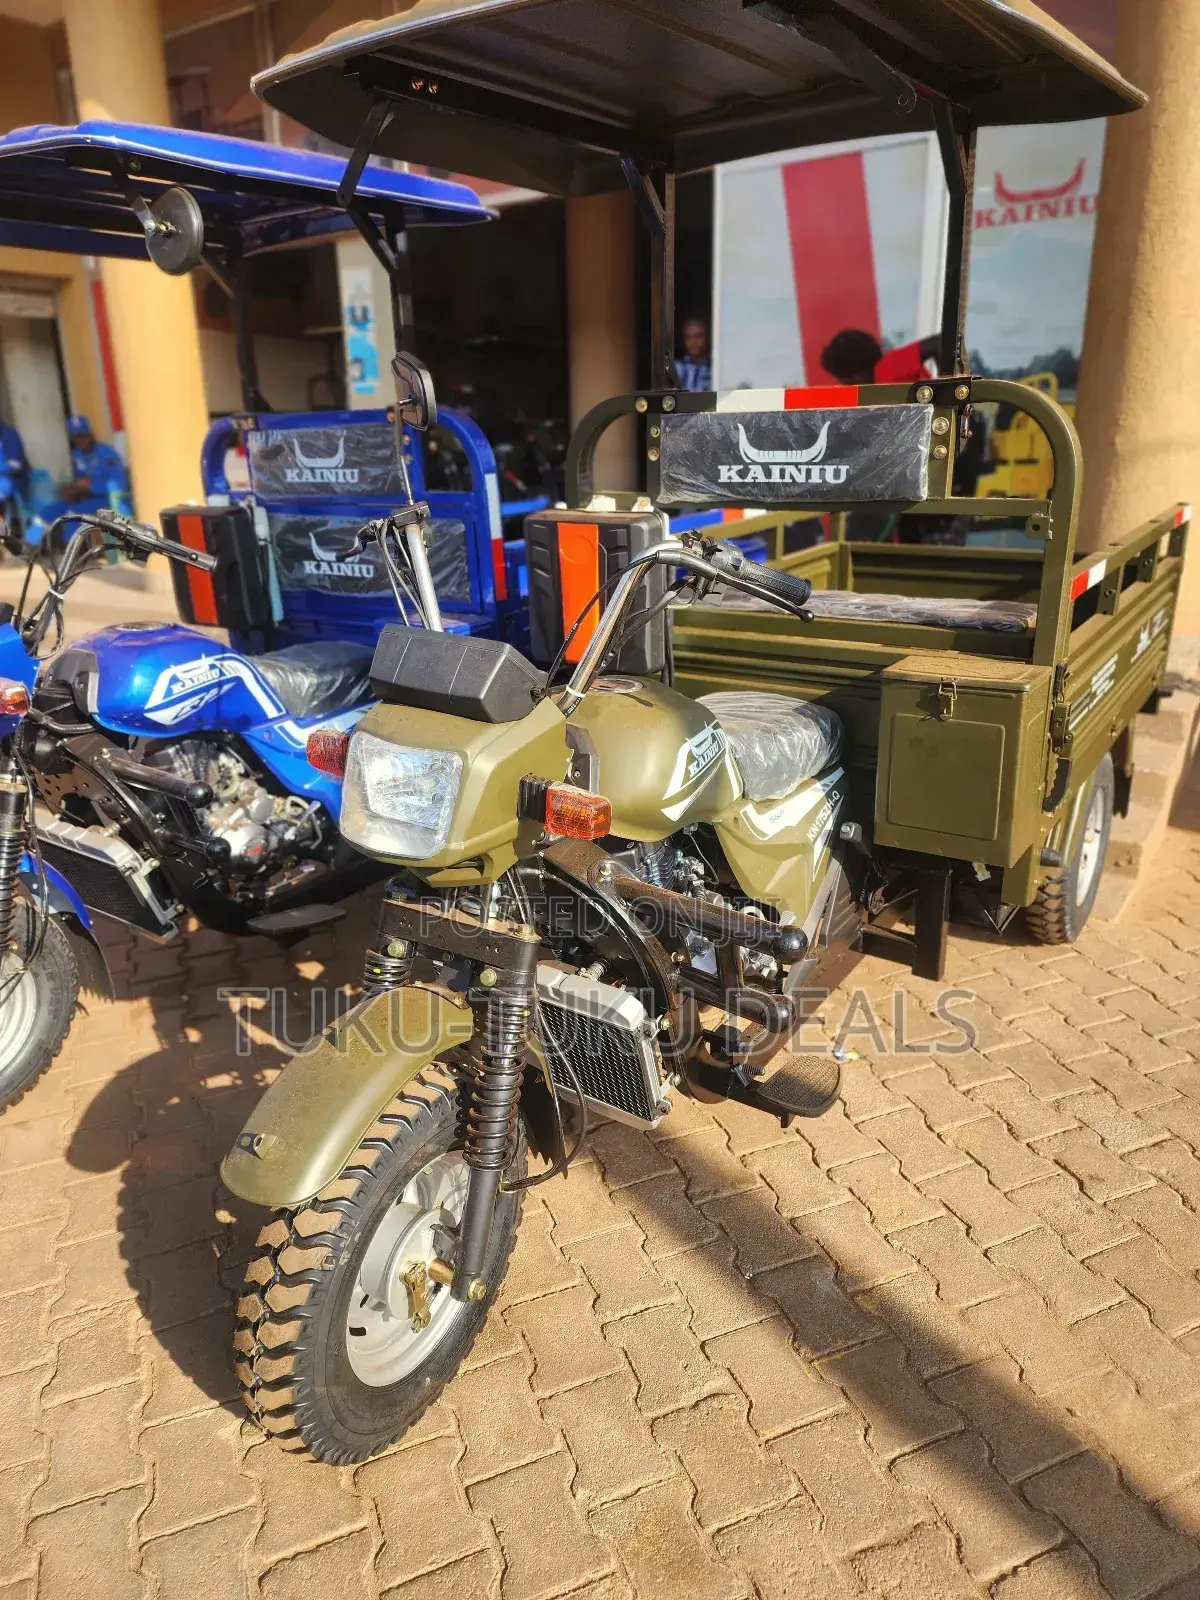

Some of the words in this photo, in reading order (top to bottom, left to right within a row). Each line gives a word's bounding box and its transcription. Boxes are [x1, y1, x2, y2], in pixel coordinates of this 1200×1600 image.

[284, 468, 360, 483] KAINIU
[717, 464, 850, 484] KAINIU
[302, 560, 374, 578] KAINIU
[807, 790, 841, 842] KN175ZH-Q
